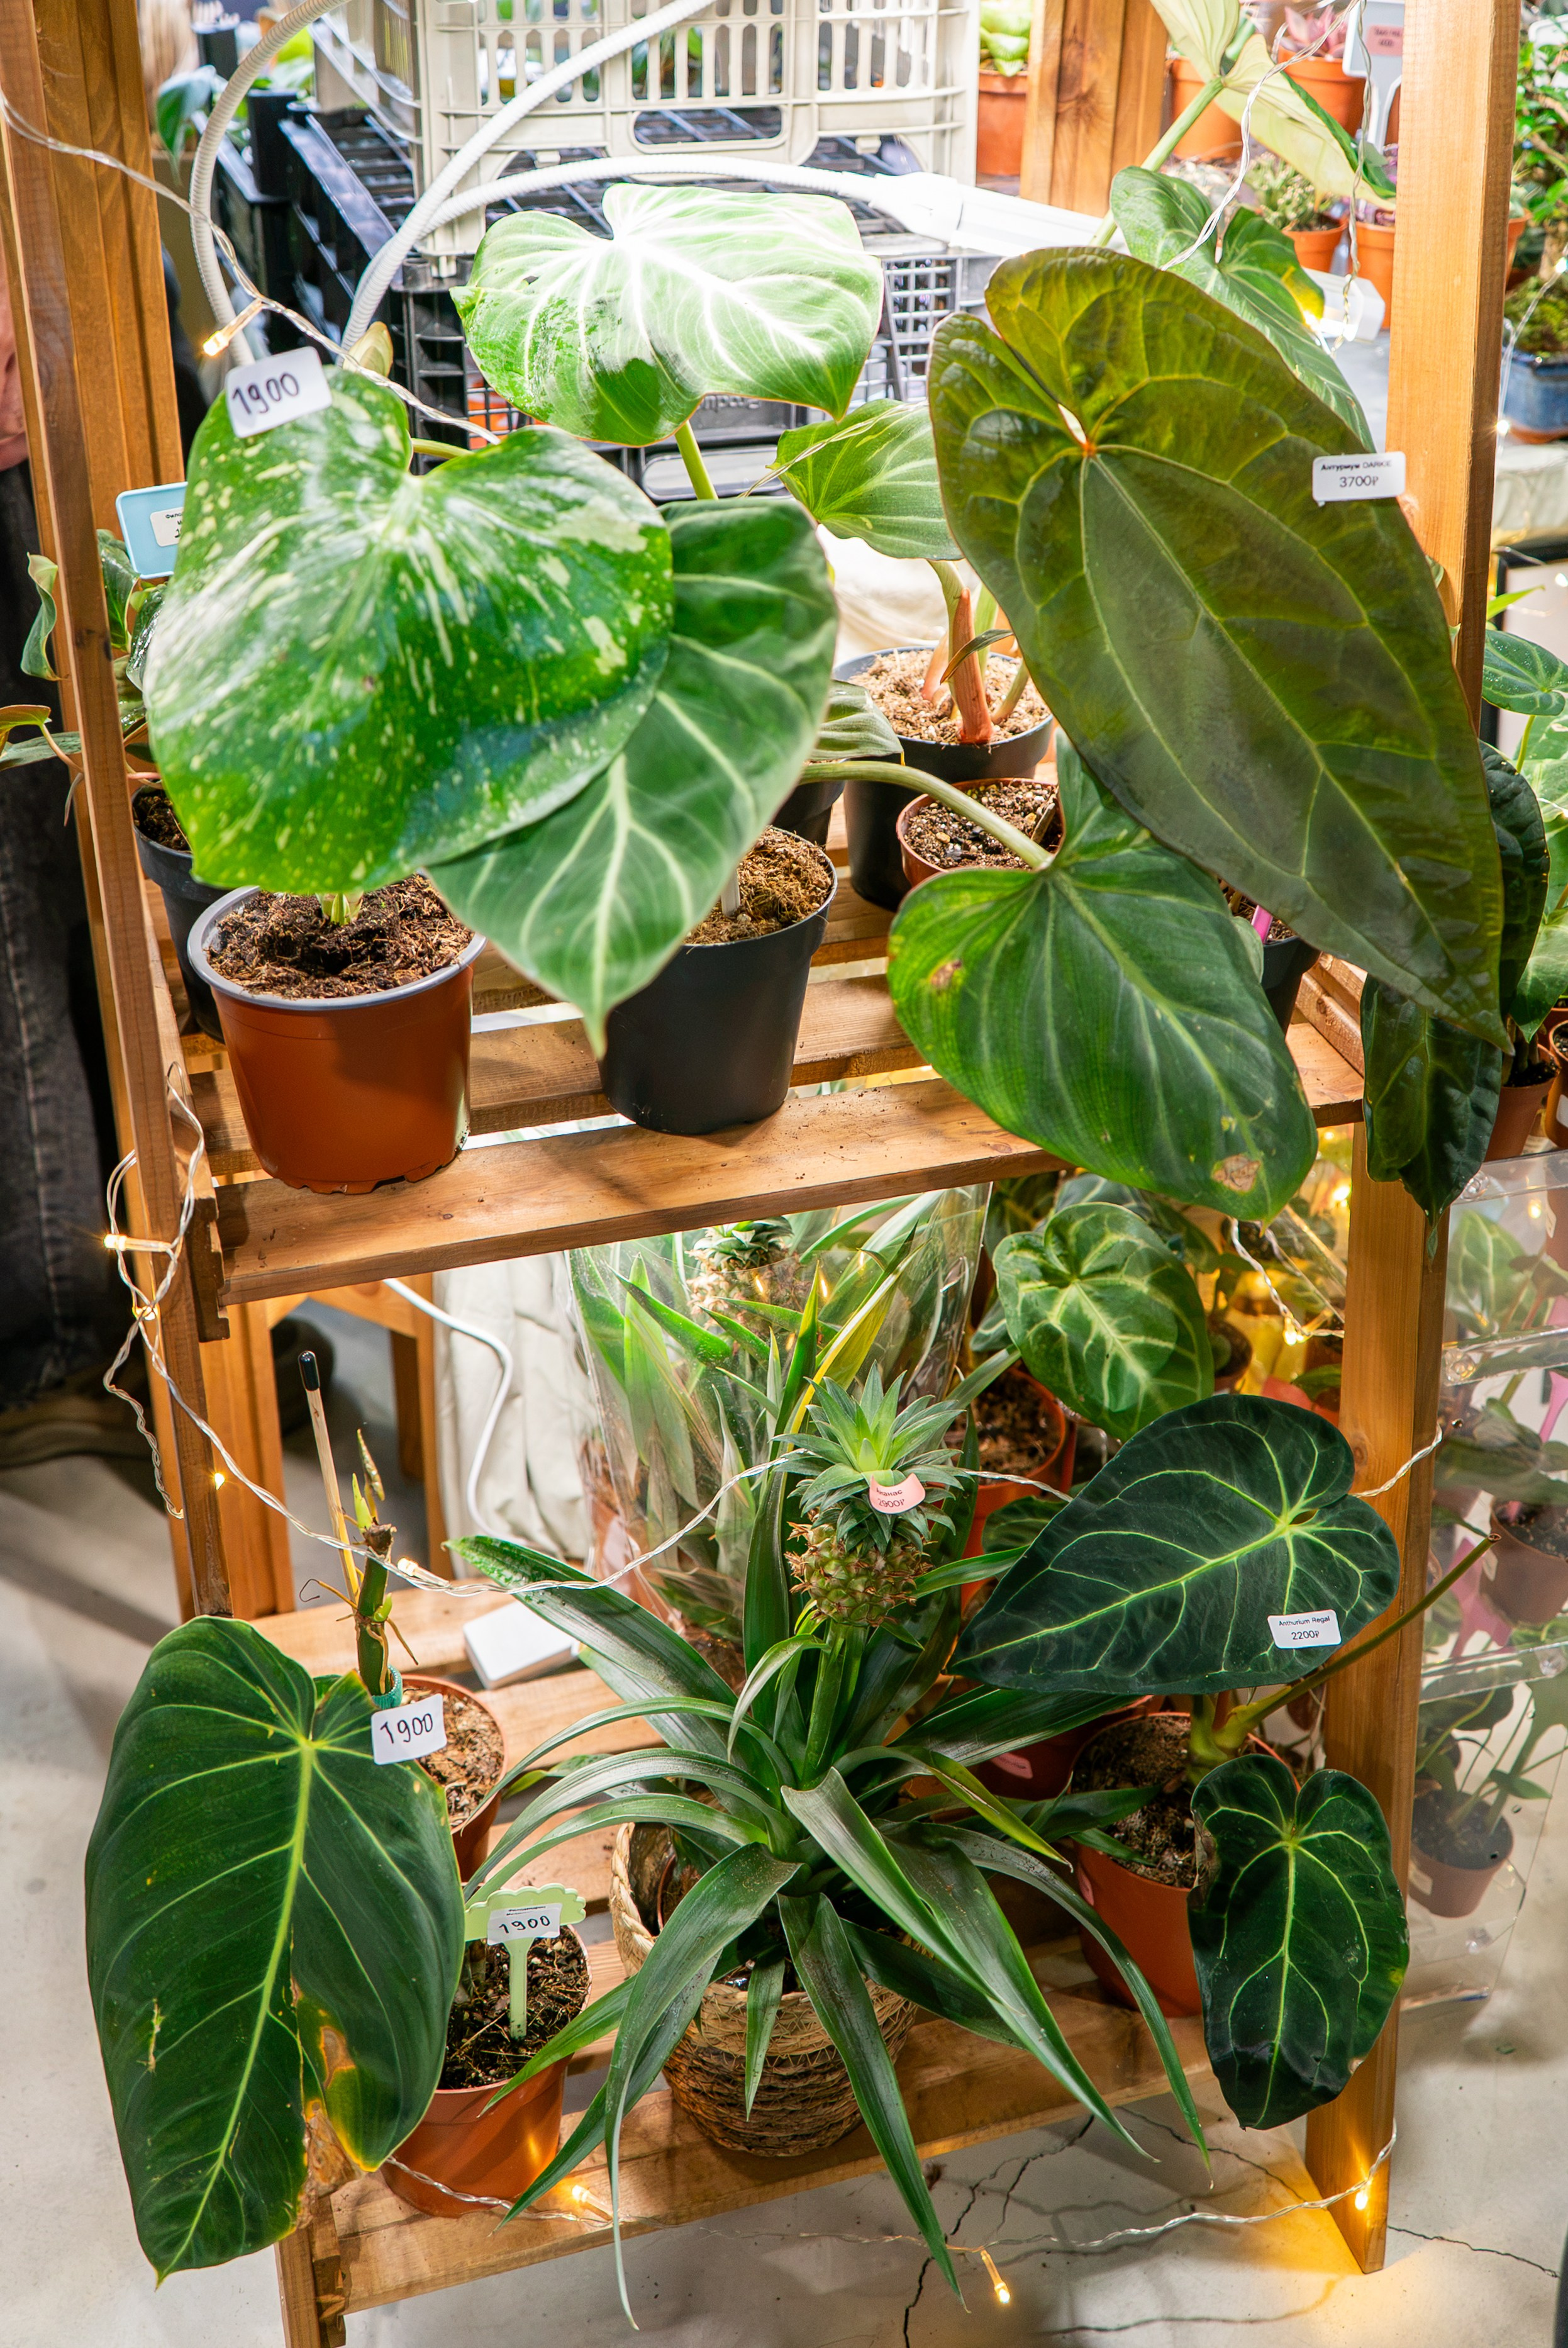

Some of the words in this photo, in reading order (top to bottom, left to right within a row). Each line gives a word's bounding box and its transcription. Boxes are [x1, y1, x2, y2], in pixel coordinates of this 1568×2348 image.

[232, 372, 299, 415] 1900
[1312, 1615, 1330, 1623] Regal
[380, 1713, 433, 1744] 1900
[499, 1915, 550, 1934] 1900
